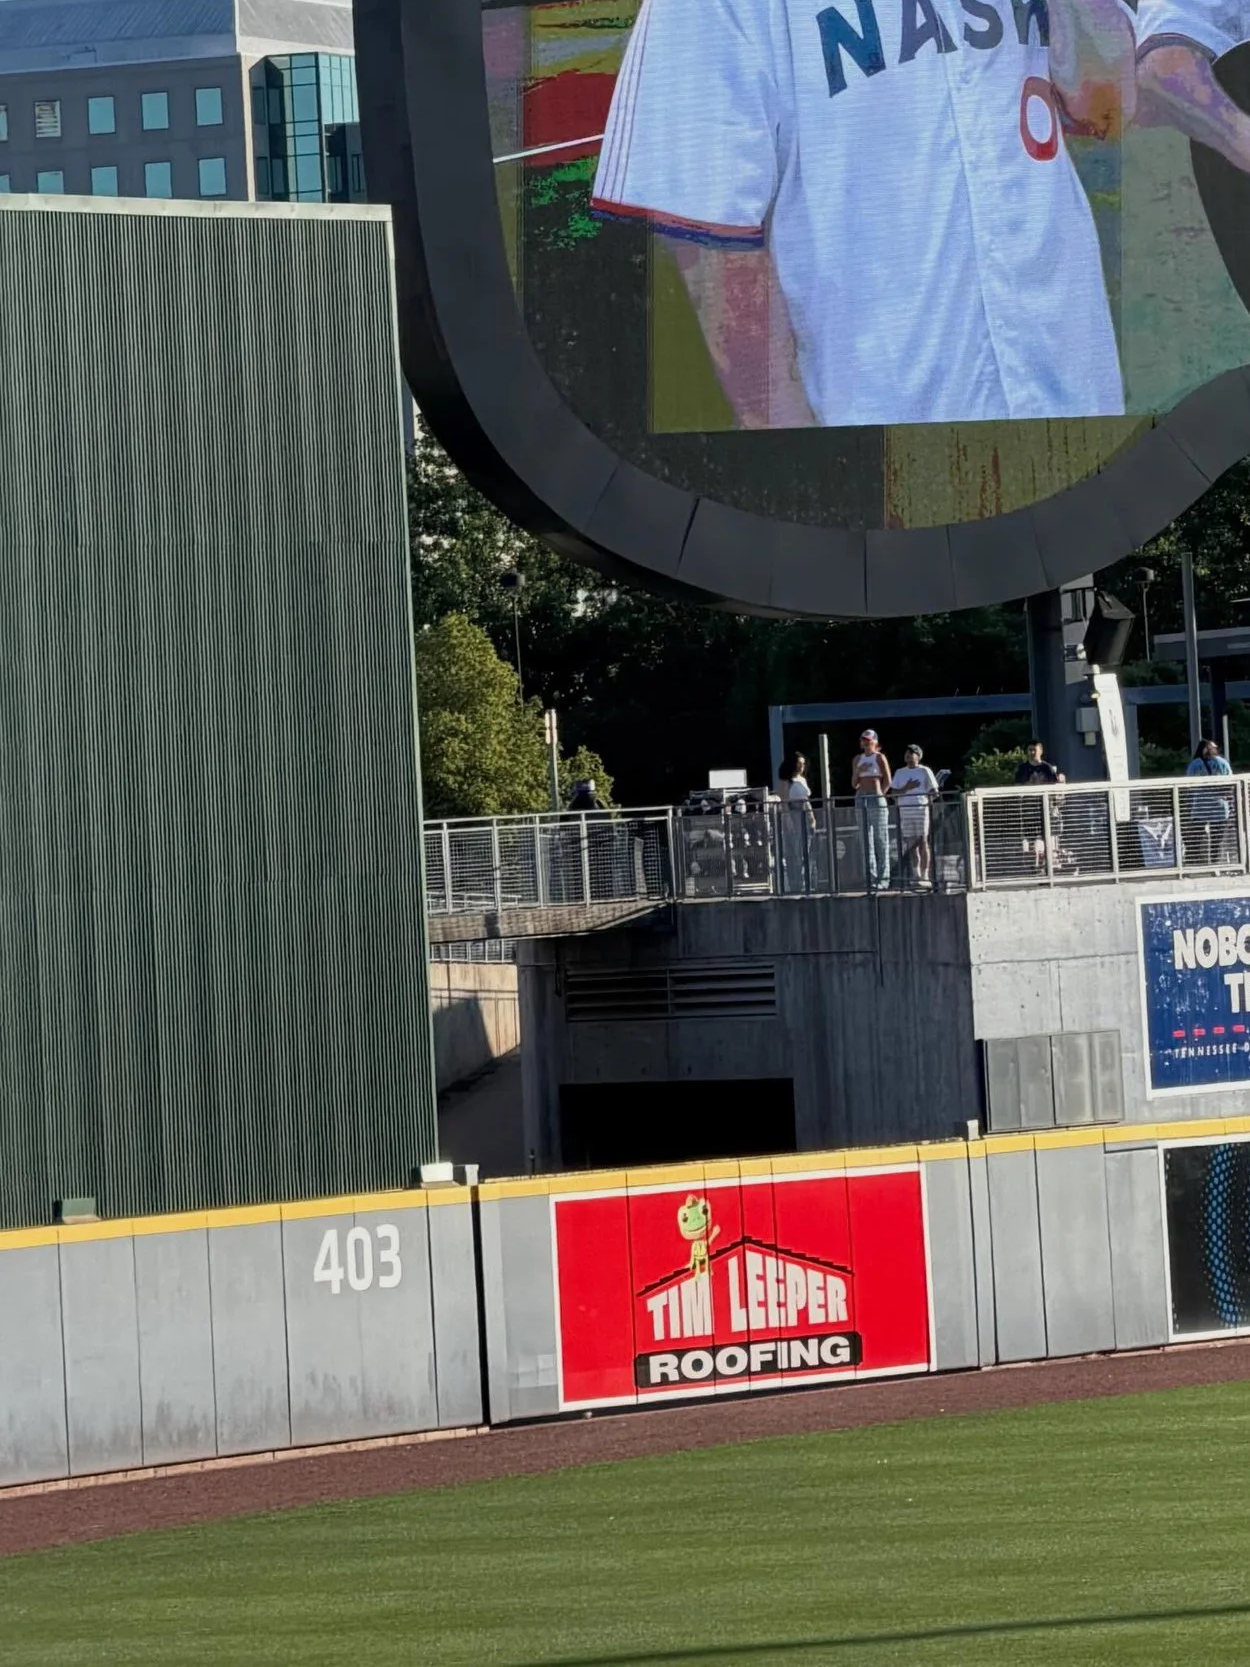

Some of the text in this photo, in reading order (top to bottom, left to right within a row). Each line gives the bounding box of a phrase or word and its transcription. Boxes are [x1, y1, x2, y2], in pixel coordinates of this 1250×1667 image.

[1173, 1045, 1238, 1059] TENNESSEE
[313, 1223, 402, 1294] 403
[646, 1249, 849, 1341] TIM LEEPER
[649, 1336, 850, 1384] ROOFING
